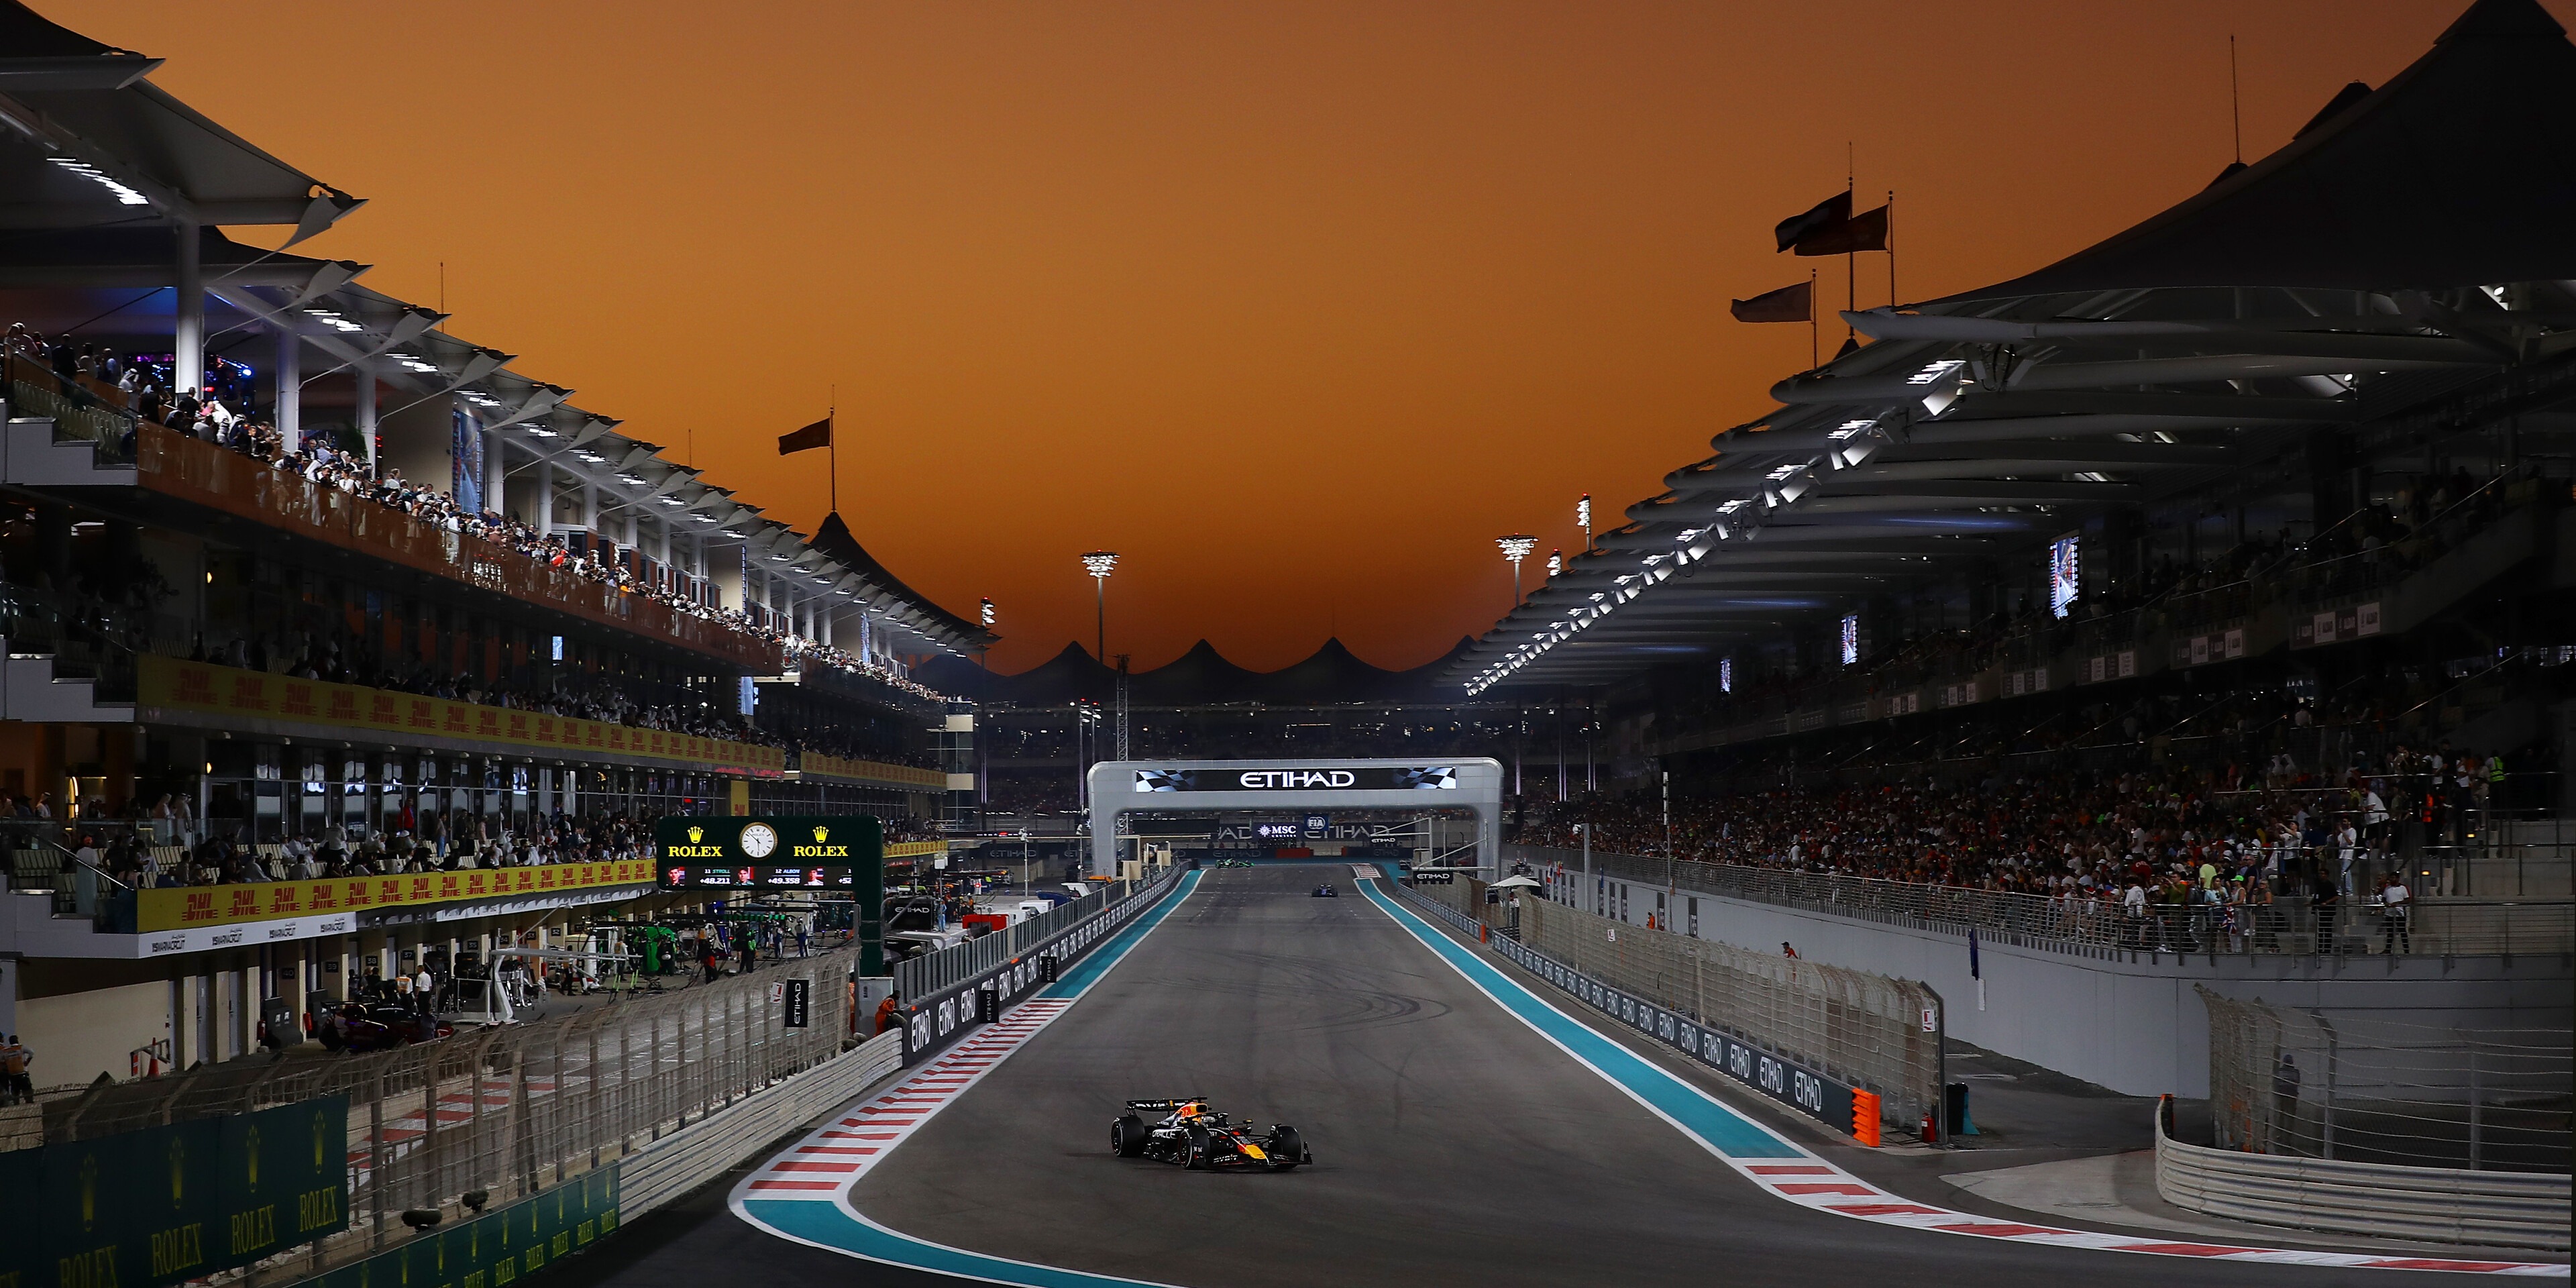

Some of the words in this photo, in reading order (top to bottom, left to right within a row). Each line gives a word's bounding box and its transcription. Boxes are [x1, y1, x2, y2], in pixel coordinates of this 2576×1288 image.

[175, 669, 215, 705] DHL
[231, 676, 266, 710] DHL
[283, 683, 315, 716] DHL
[1240, 771, 1355, 788] ETIHAD
[1271, 825, 1297, 834] MSC
[668, 846, 723, 857] ROLEX
[794, 845, 848, 857] ROLEX
[1213, 849, 1261, 857] ETIHAD
[184, 893, 215, 921] DHL
[230, 890, 258, 916] DHL
[272, 887, 298, 913] DHL
[311, 885, 335, 909] DHL
[346, 882, 370, 906] DHL
[794, 982, 802, 1024] ETIHAD
[911, 1009, 931, 1053] ETIHAD
[938, 997, 955, 1037] ETIHAD
[960, 987, 976, 1023] ETIHAD
[1659, 1012, 1674, 1041] ETIHAD
[1680, 1022, 1697, 1053] ETIHAD
[1703, 1032, 1721, 1065] ETIHAD
[1730, 1043, 1750, 1079] ETIHAD
[1760, 1056, 1783, 1094] ETIHAD
[1794, 1070, 1822, 1112] ETIHAD
[1152, 1129, 1177, 1140] ORACLE
[152, 1222, 203, 1277] ROLEX
[231, 1203, 275, 1255] ROLEX
[299, 1185, 337, 1233] ROLEX
